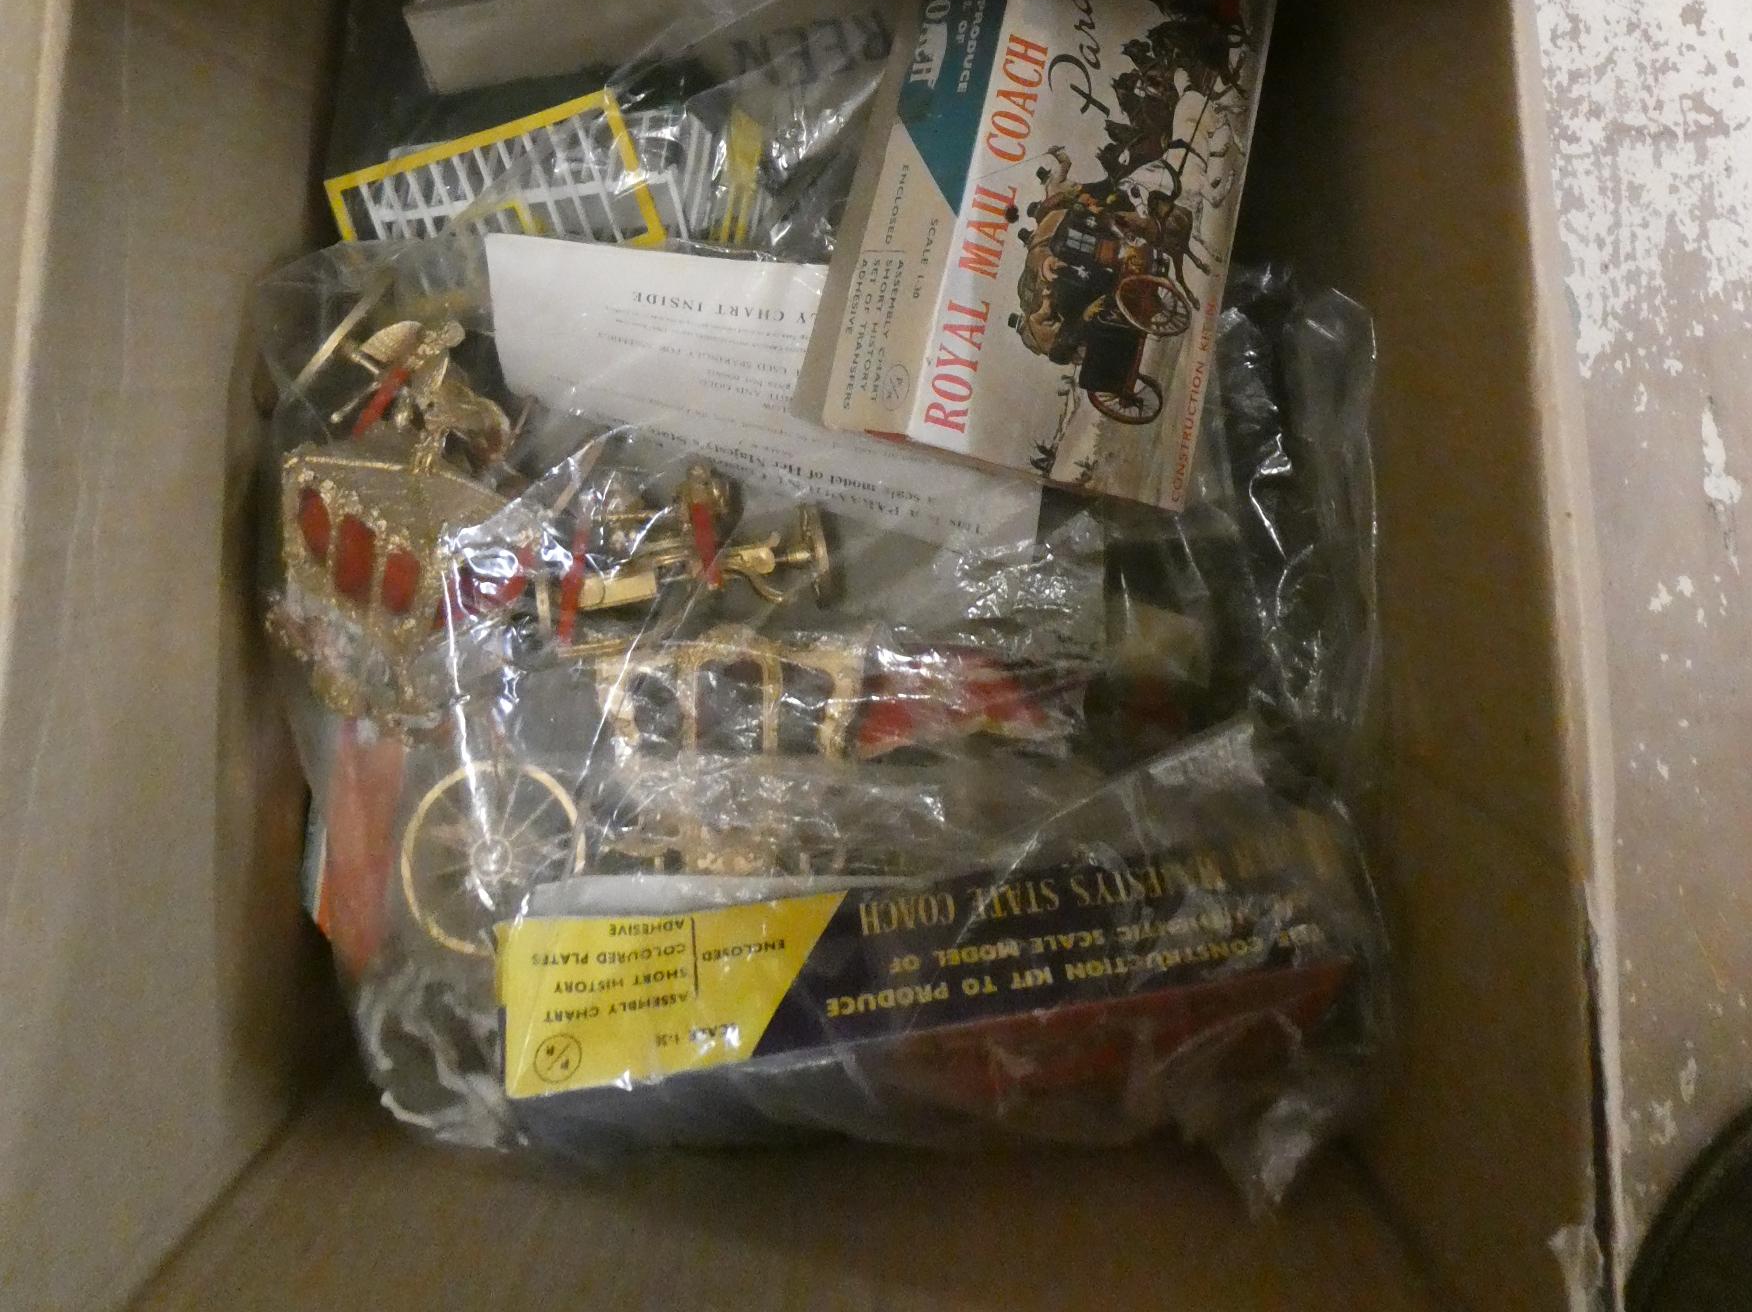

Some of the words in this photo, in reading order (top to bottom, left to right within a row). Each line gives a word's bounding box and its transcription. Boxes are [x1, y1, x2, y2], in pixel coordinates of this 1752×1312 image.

[957, 0, 986, 94] PRODUCE
[985, 33, 1049, 164] COACH
[885, 164, 910, 245] ENCLOSED
[919, 218, 940, 266] SCALE
[957, 183, 1018, 281] MAIL
[870, 259, 881, 287] SET
[875, 259, 894, 312] SHORT
[631, 290, 704, 313] INSIDE
[715, 303, 785, 323] CHART
[845, 259, 868, 336] ADHESIVE
[863, 292, 873, 313] OF
[882, 259, 905, 339] ASSEMBLY
[842, 323, 868, 411] TRANSFERS
[858, 321, 878, 392] HISTORY
[924, 299, 991, 434] ROYAL
[869, 346, 886, 402] CHART
[1170, 361, 1205, 504] CONSTRUCTION
[858, 891, 957, 937] COACH
[970, 878, 1060, 922] STATE
[608, 918, 686, 937] ADHESIVE
[531, 950, 590, 967] PLATES
[598, 941, 687, 966] COLOURED
[701, 938, 787, 963] ENCLOSED
[889, 953, 921, 974] OF
[932, 939, 1022, 969] MODEL
[553, 975, 625, 995] HISTORY
[632, 966, 689, 987] SHORT
[961, 975, 998, 997] TO
[1010, 966, 1054, 991] KIT
[544, 1003, 600, 1023] CHART
[607, 990, 689, 1015] ASSEMBLY
[825, 981, 950, 1019] PRODUCE
